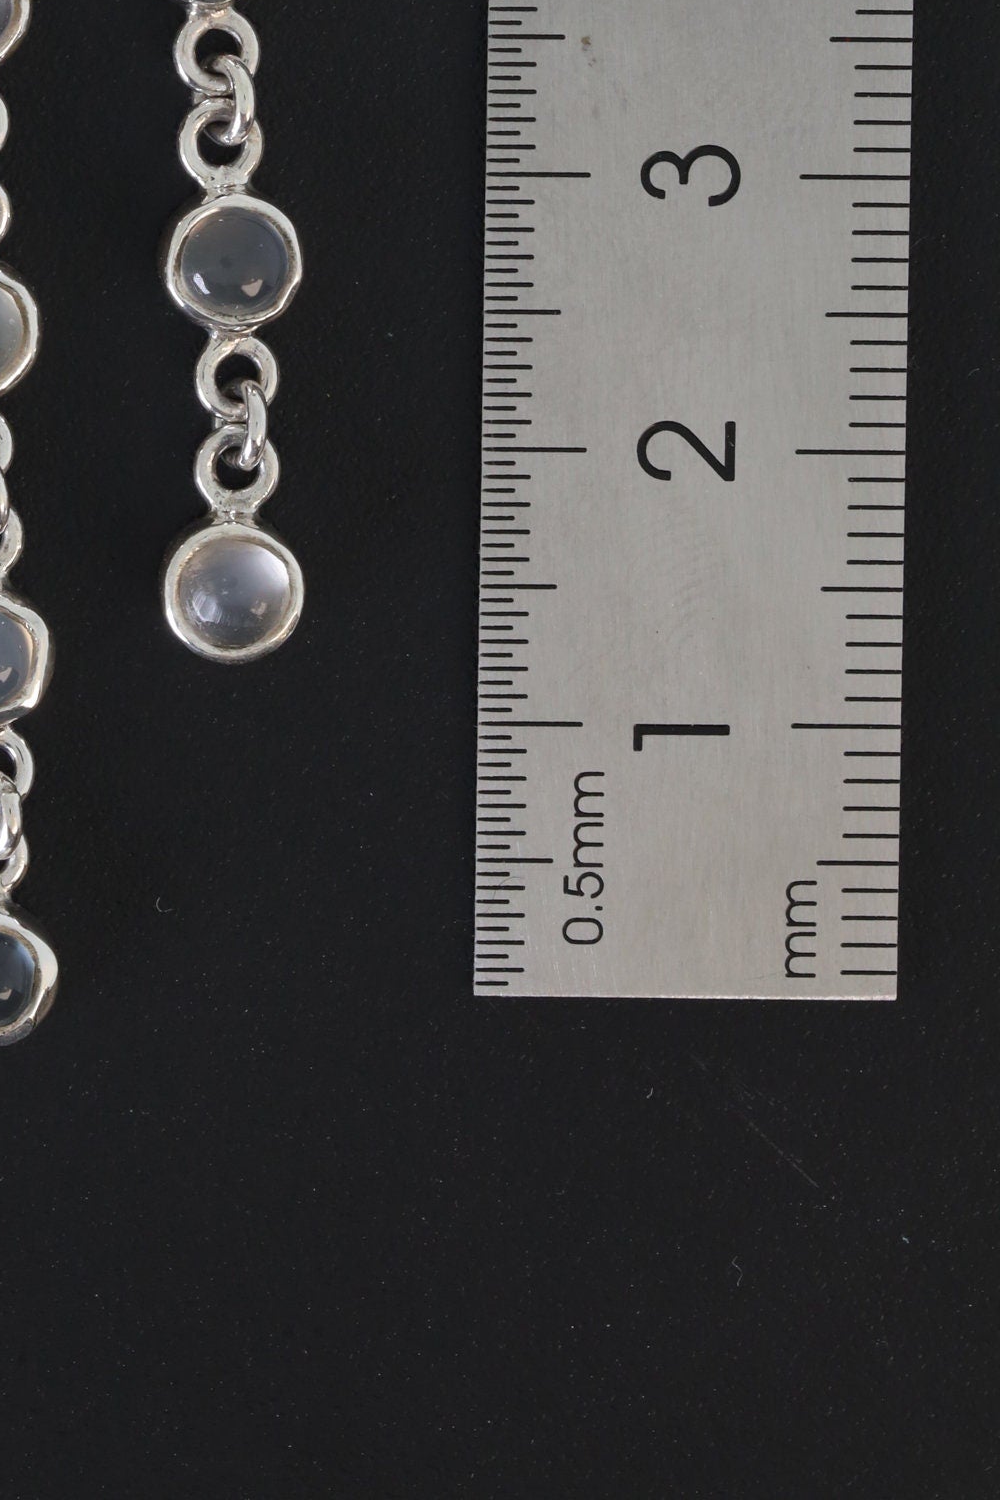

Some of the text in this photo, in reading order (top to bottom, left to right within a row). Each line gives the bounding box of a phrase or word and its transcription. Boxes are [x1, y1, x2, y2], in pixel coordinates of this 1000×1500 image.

[640, 145, 742, 207] 3
[636, 420, 737, 482] 2
[632, 723, 731, 752] 1
[561, 771, 605, 945] 0.5mm
[784, 880, 818, 979] mm
